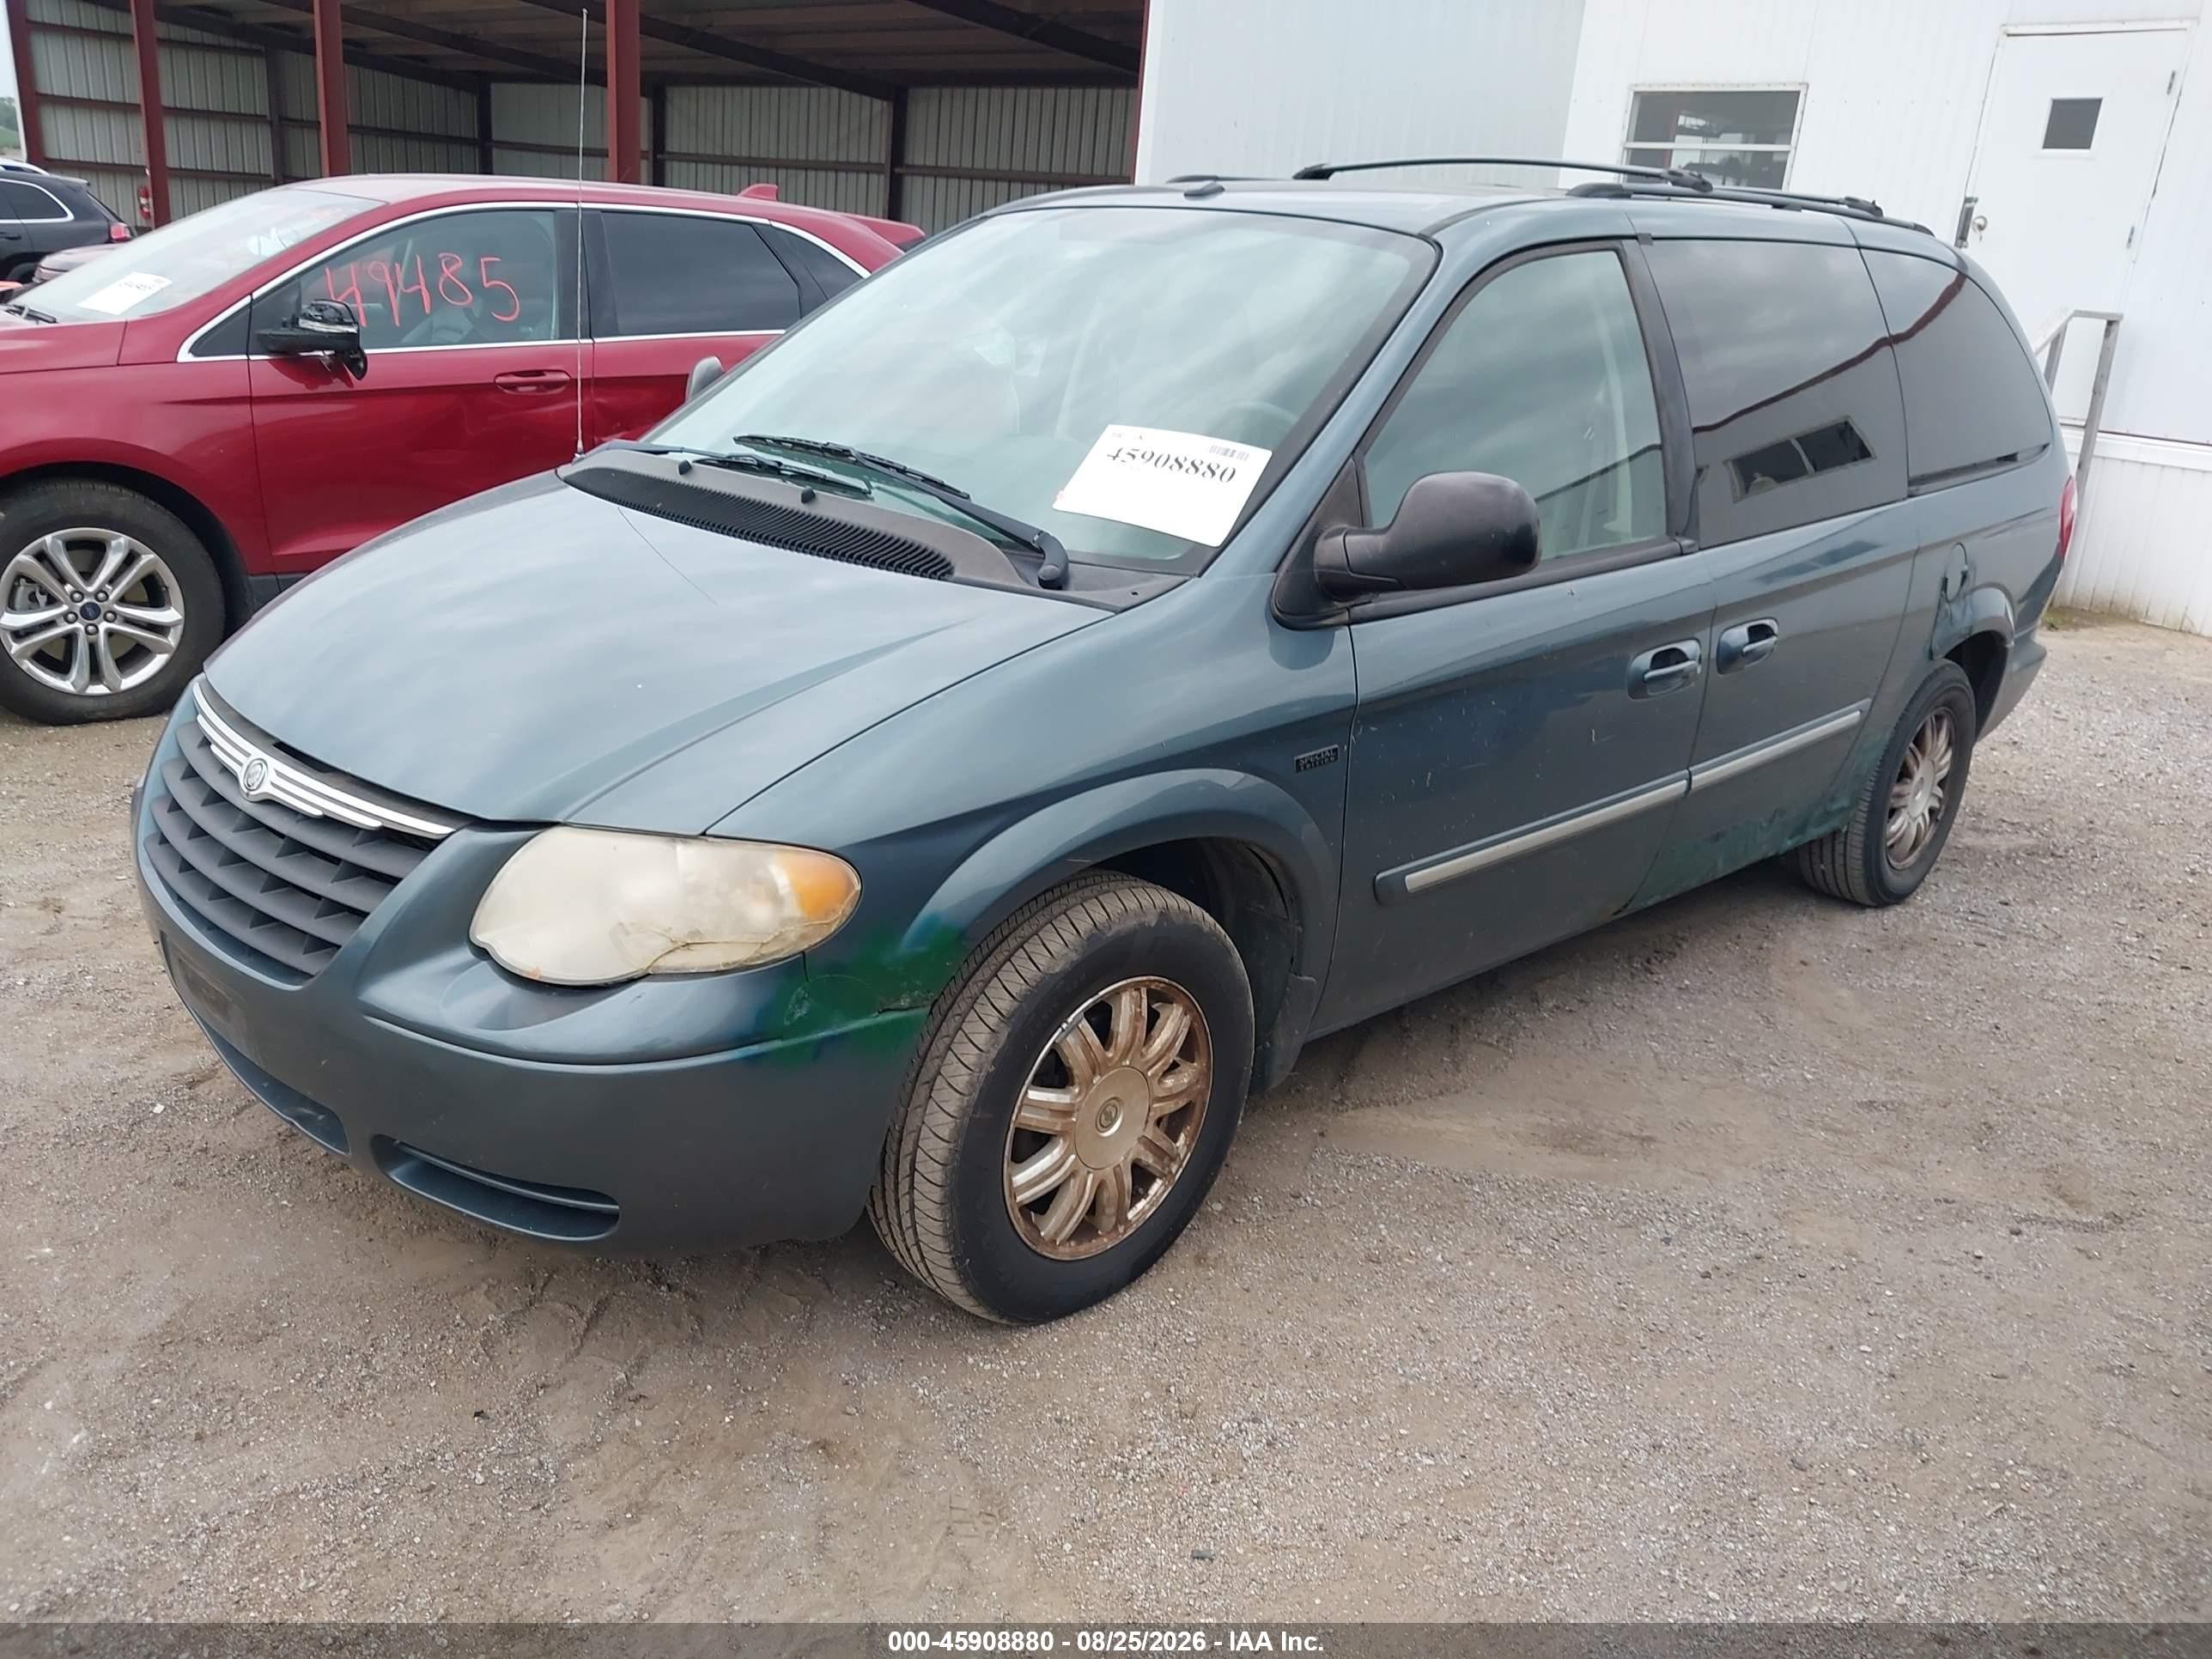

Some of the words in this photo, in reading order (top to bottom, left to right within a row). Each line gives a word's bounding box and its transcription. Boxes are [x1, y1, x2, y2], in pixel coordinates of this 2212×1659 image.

[325, 252, 521, 328] 49485
[1106, 447, 1237, 483] 45908880
[1298, 749, 1335, 764] SPECIAL
